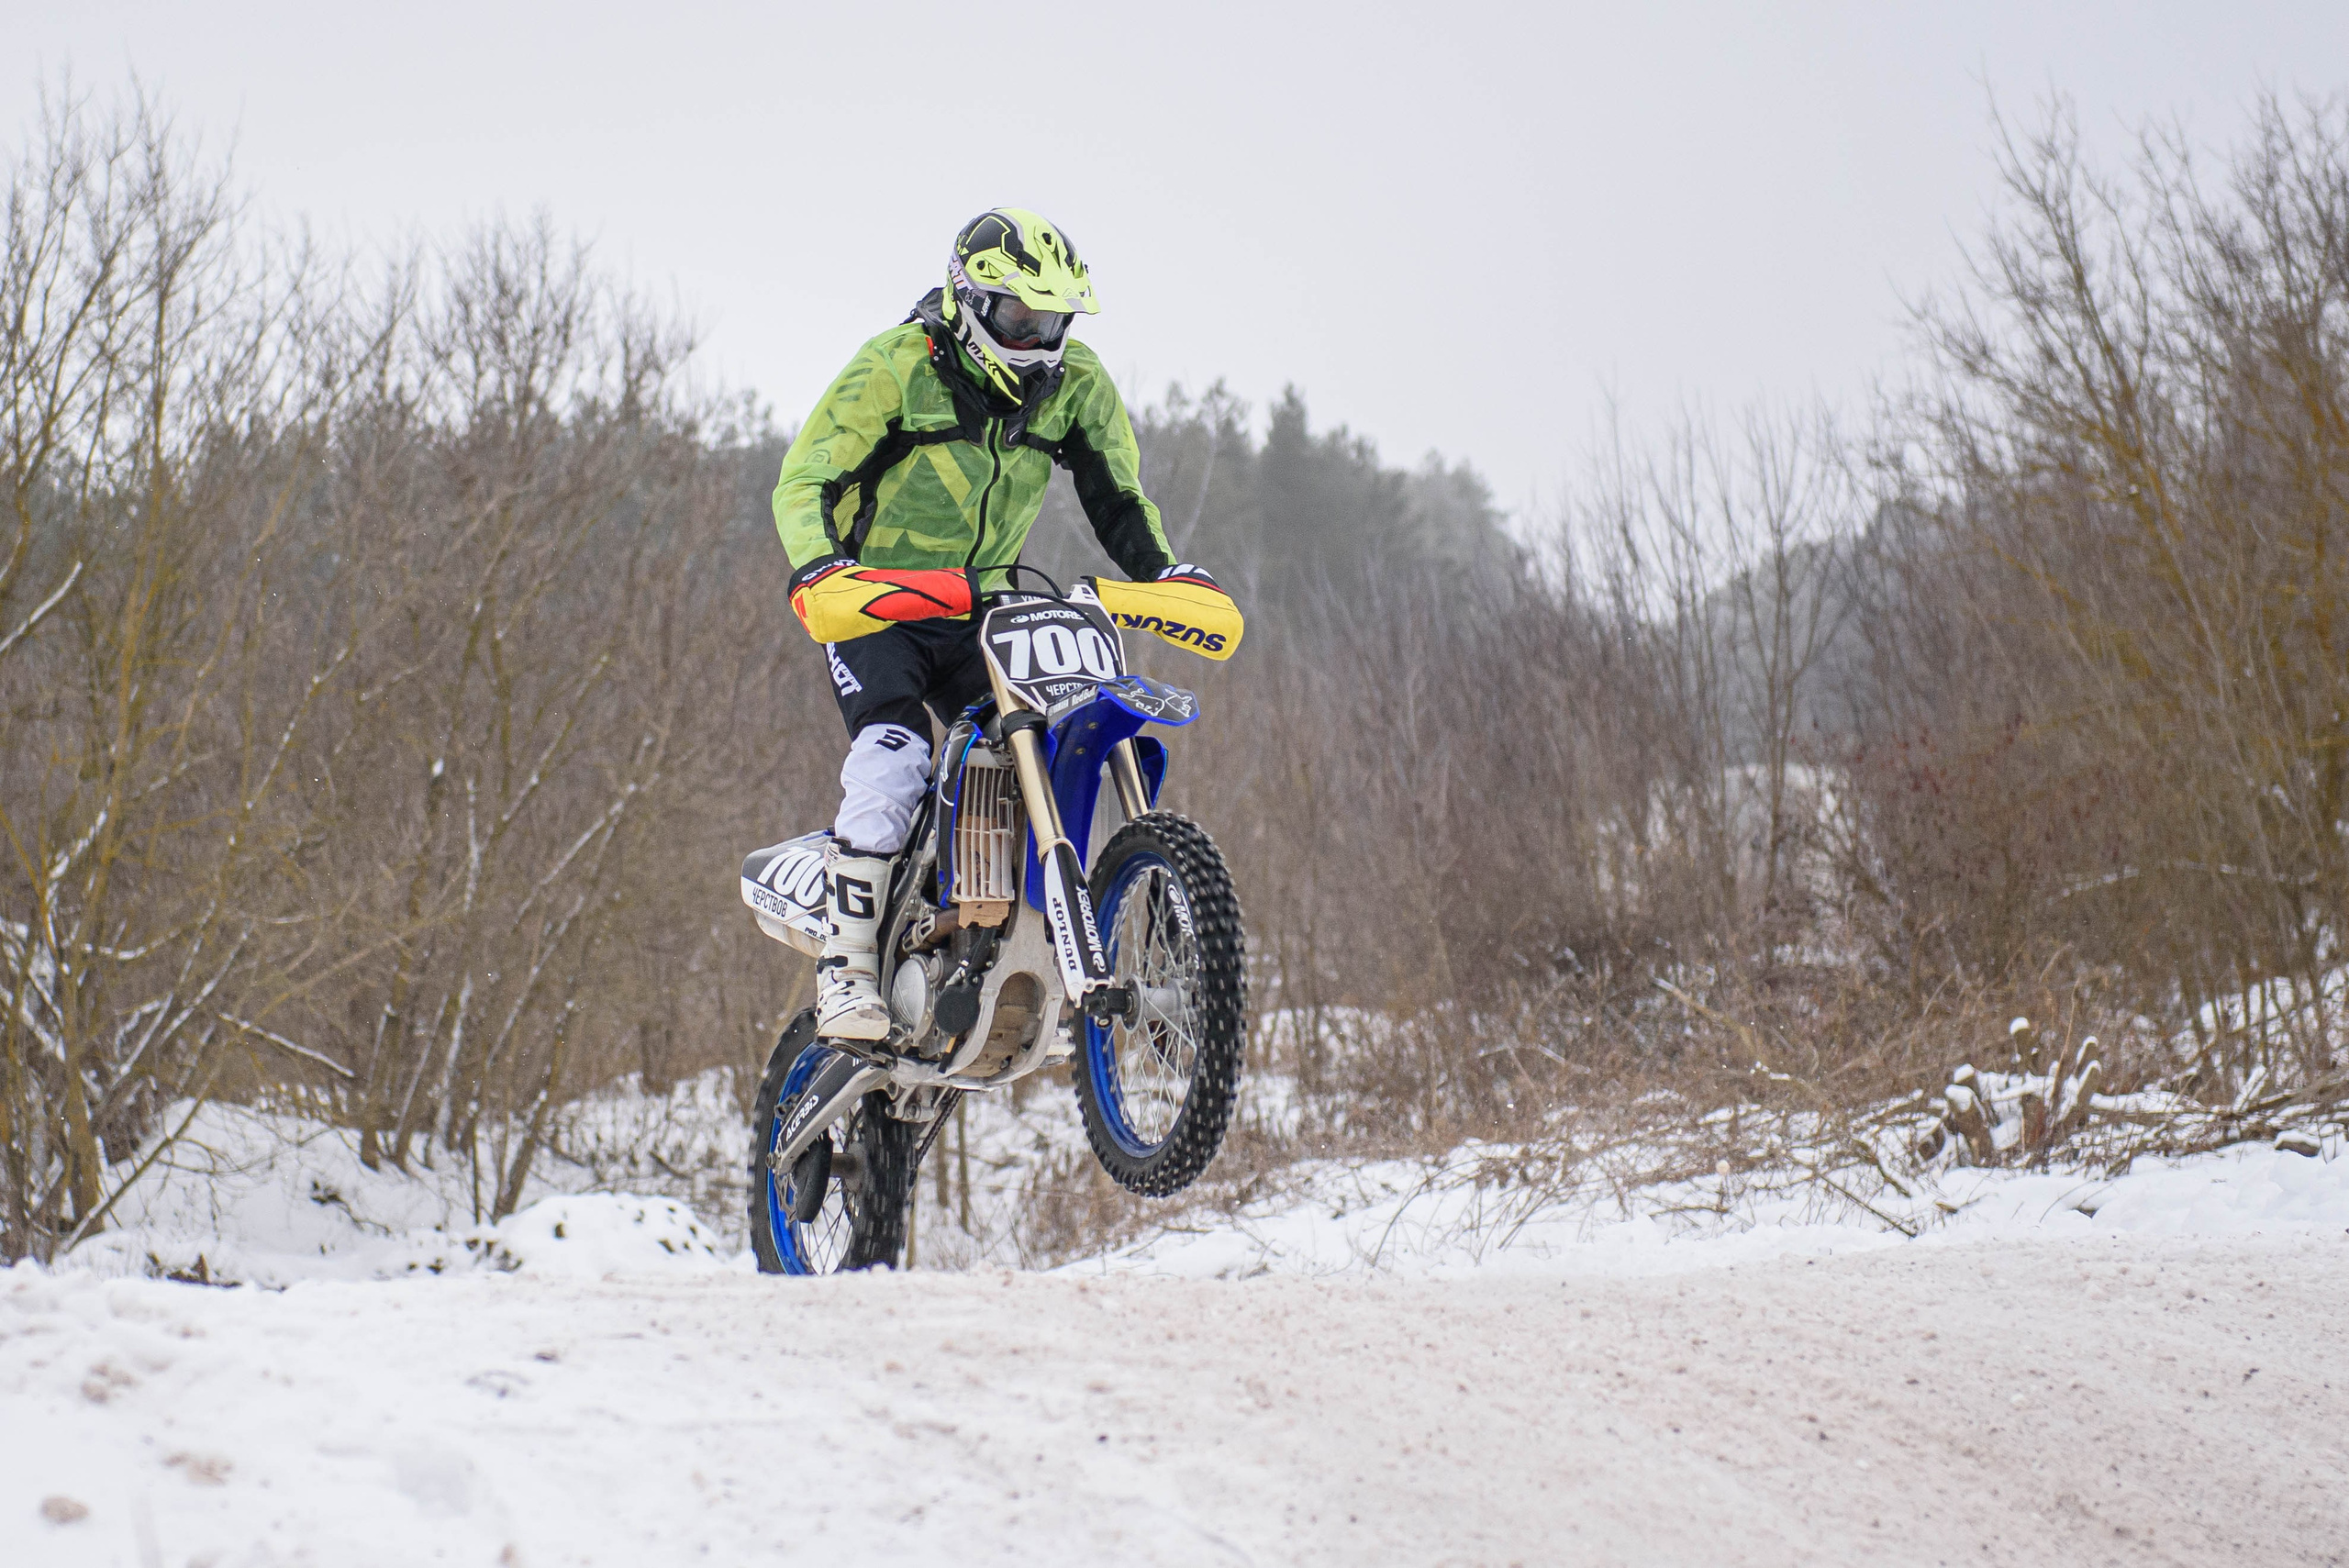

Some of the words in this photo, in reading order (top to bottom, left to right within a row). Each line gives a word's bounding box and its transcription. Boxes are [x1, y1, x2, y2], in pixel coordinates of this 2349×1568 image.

[1030, 609, 1090, 622] MOTORE
[1110, 612, 1227, 652] SUZUKI
[992, 624, 1122, 680] 700
[751, 886, 788, 918] ЧЕРСТВОВ
[1075, 884, 1103, 952] MOTOREX
[1052, 897, 1078, 972] DUNLOP
